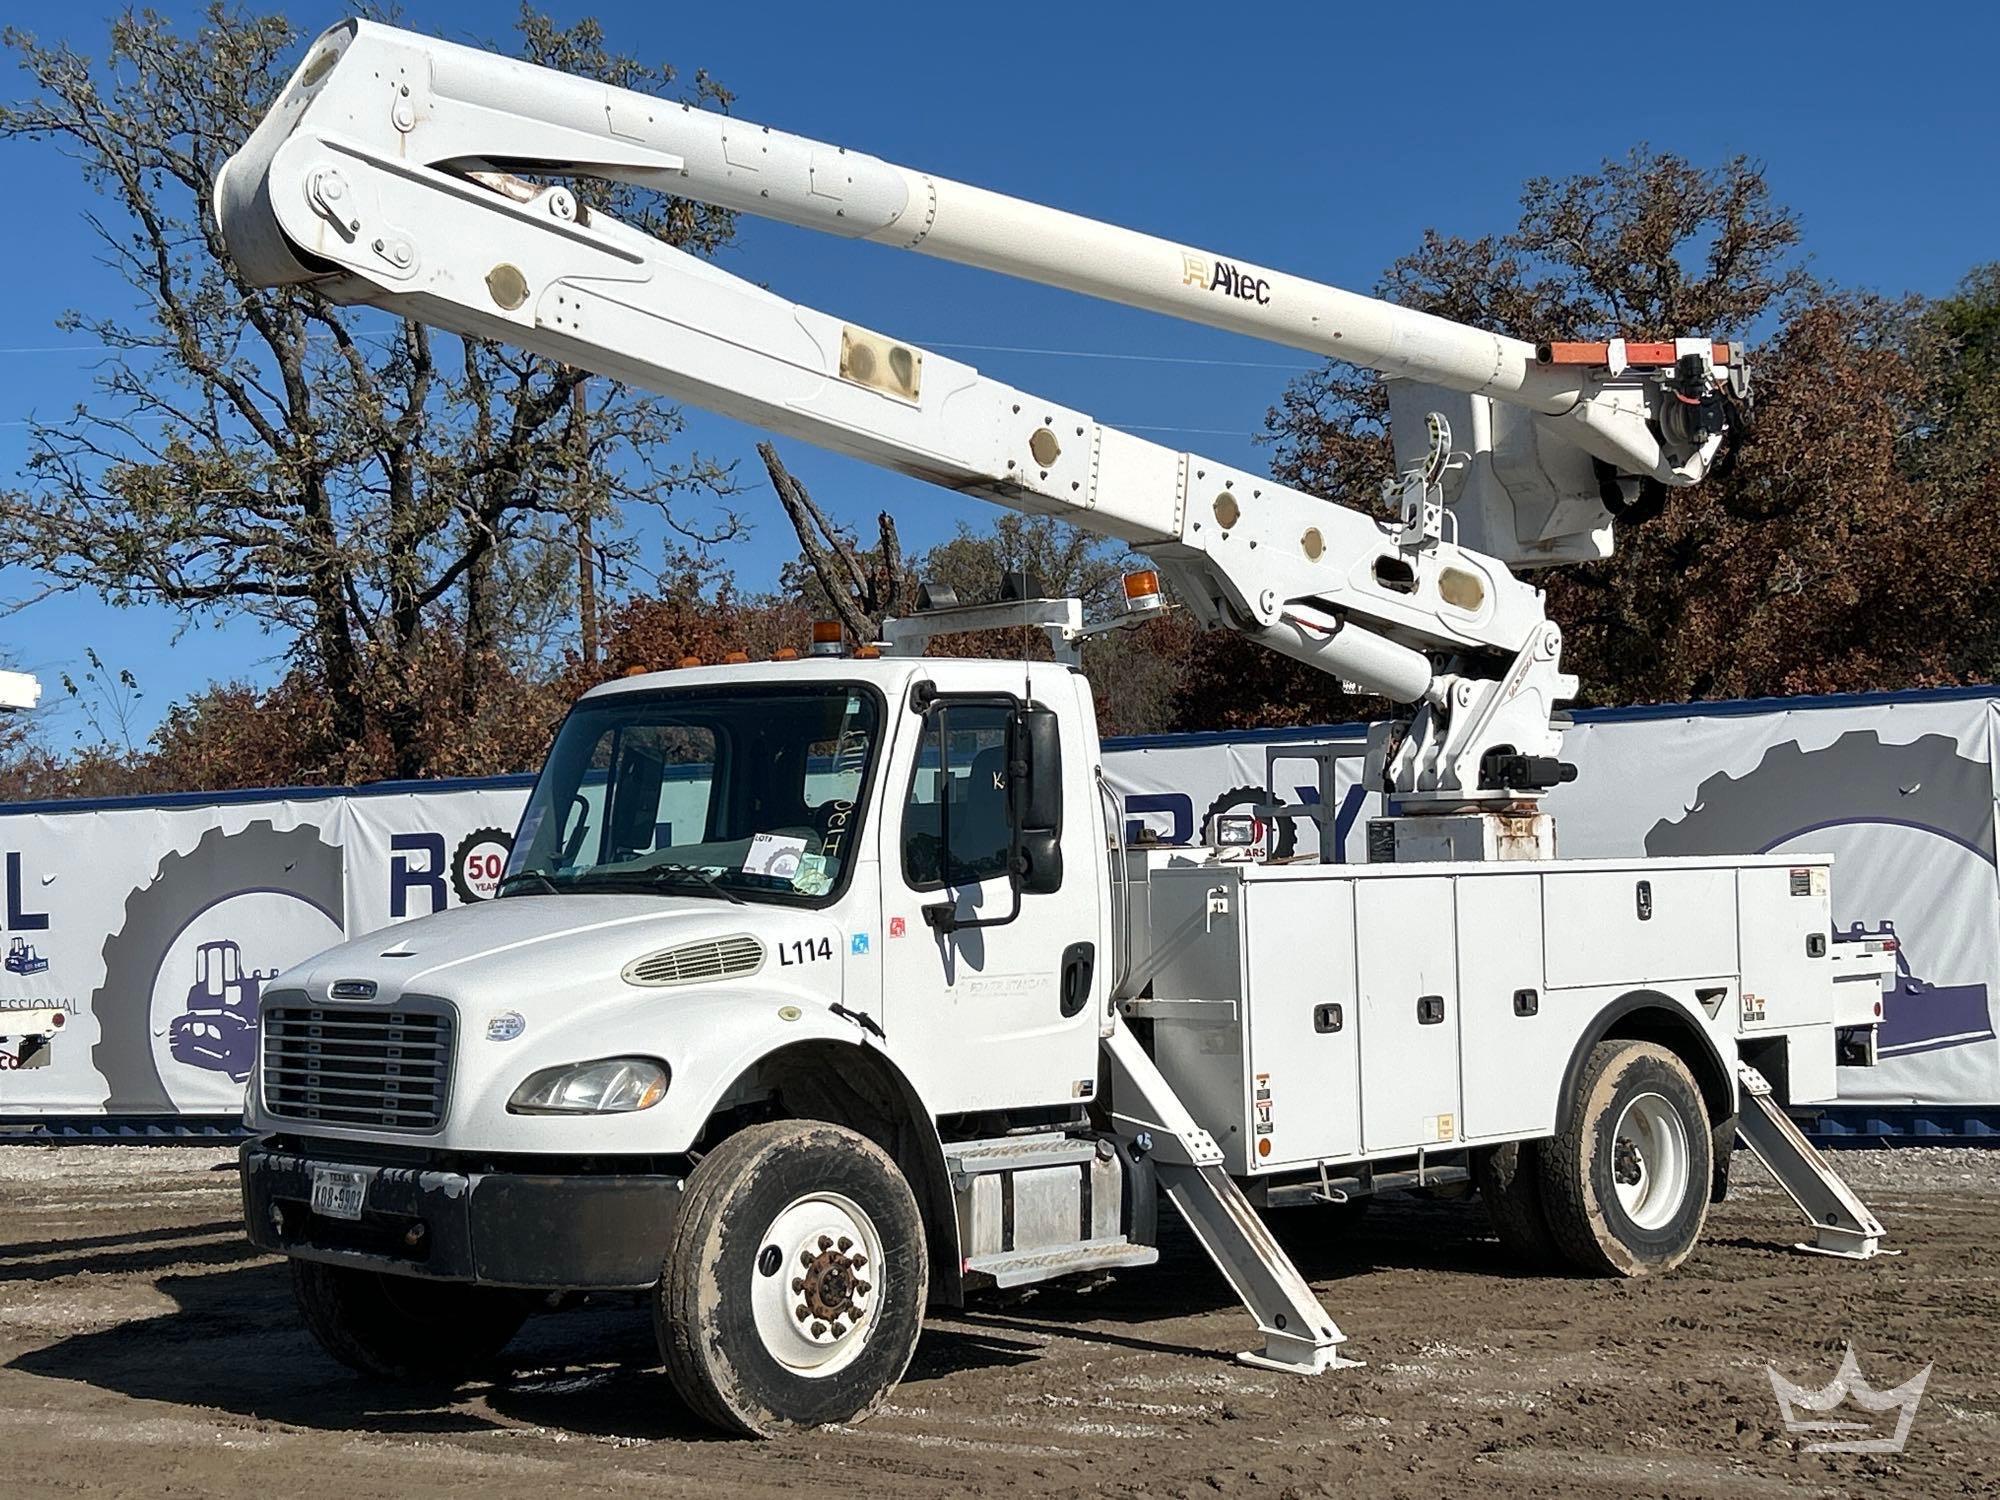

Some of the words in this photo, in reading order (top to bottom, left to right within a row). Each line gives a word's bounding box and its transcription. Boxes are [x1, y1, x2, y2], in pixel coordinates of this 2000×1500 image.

[1209, 262, 1270, 305] Altec
[468, 854, 502, 880] 50
[778, 937, 833, 967] L114
